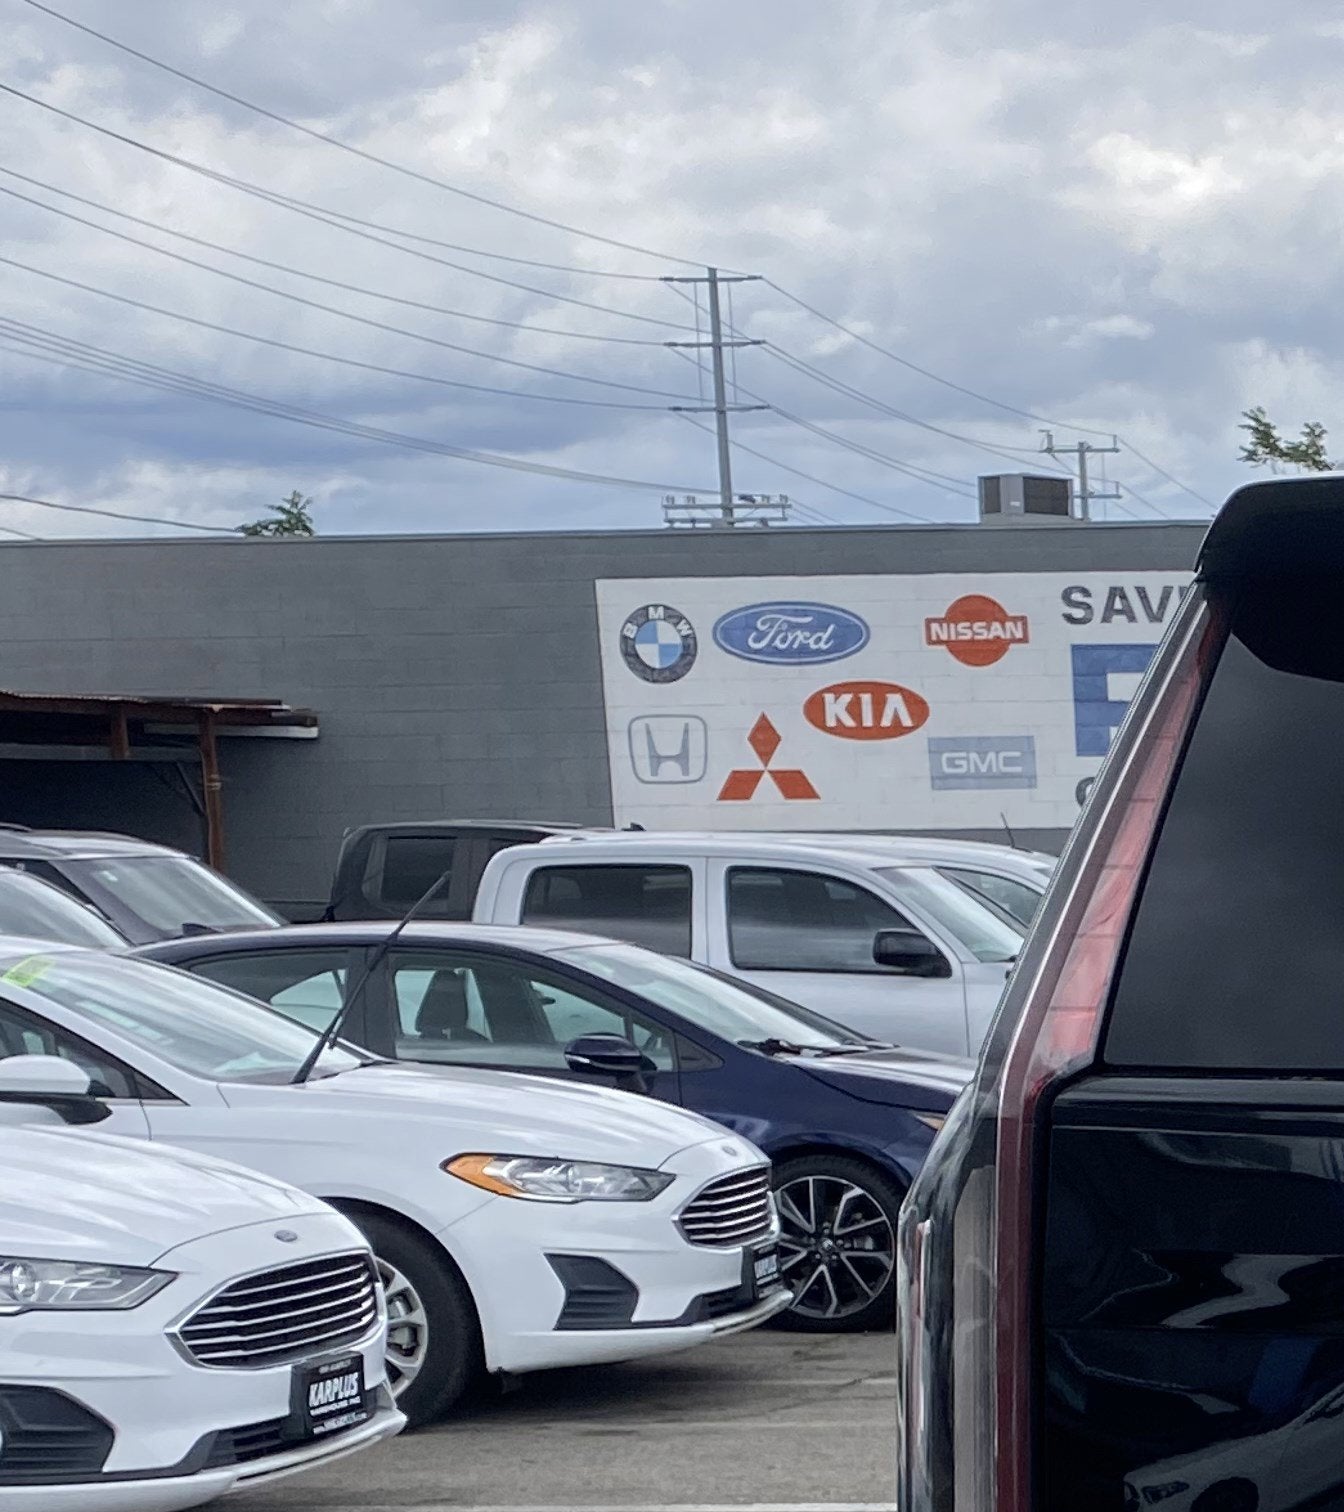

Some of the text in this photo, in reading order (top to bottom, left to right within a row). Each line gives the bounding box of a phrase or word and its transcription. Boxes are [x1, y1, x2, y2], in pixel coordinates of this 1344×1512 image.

[1061, 585, 1190, 625] SAV
[747, 613, 836, 650] Ford
[930, 620, 1024, 641] NISSAN
[822, 692, 913, 728] KIA
[941, 751, 1023, 774] GMC
